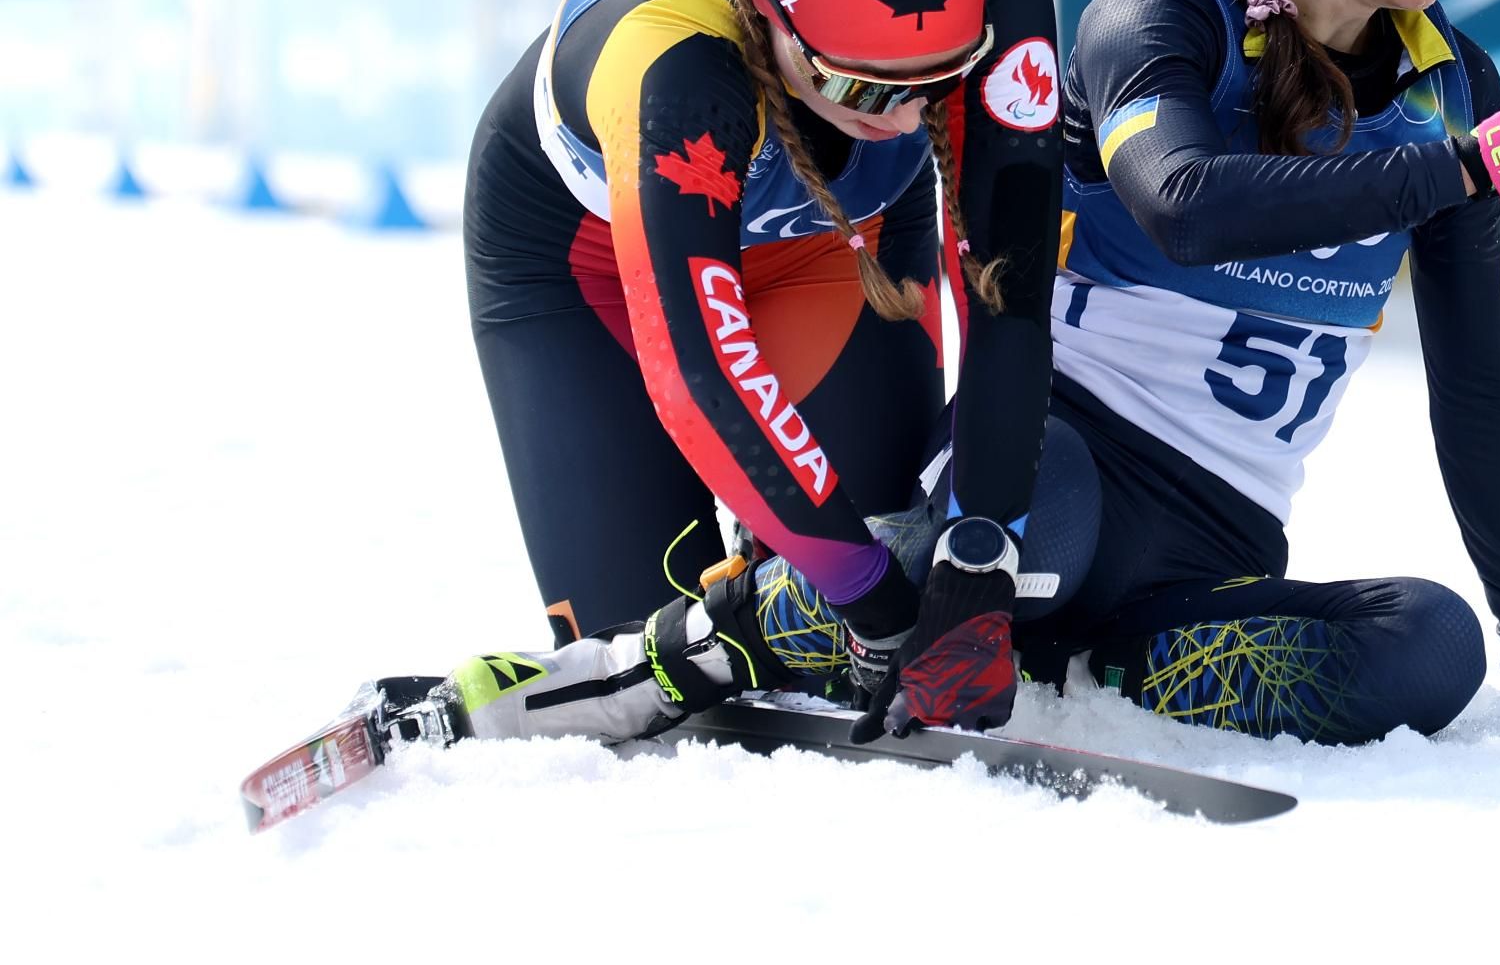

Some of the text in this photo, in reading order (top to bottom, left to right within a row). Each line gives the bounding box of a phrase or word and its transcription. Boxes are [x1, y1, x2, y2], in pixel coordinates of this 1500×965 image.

[1214, 262, 1294, 288] MILANO
[1297, 276, 1376, 298] CORTINA
[700, 265, 828, 496] CANADA
[1203, 310, 1348, 445] 51
